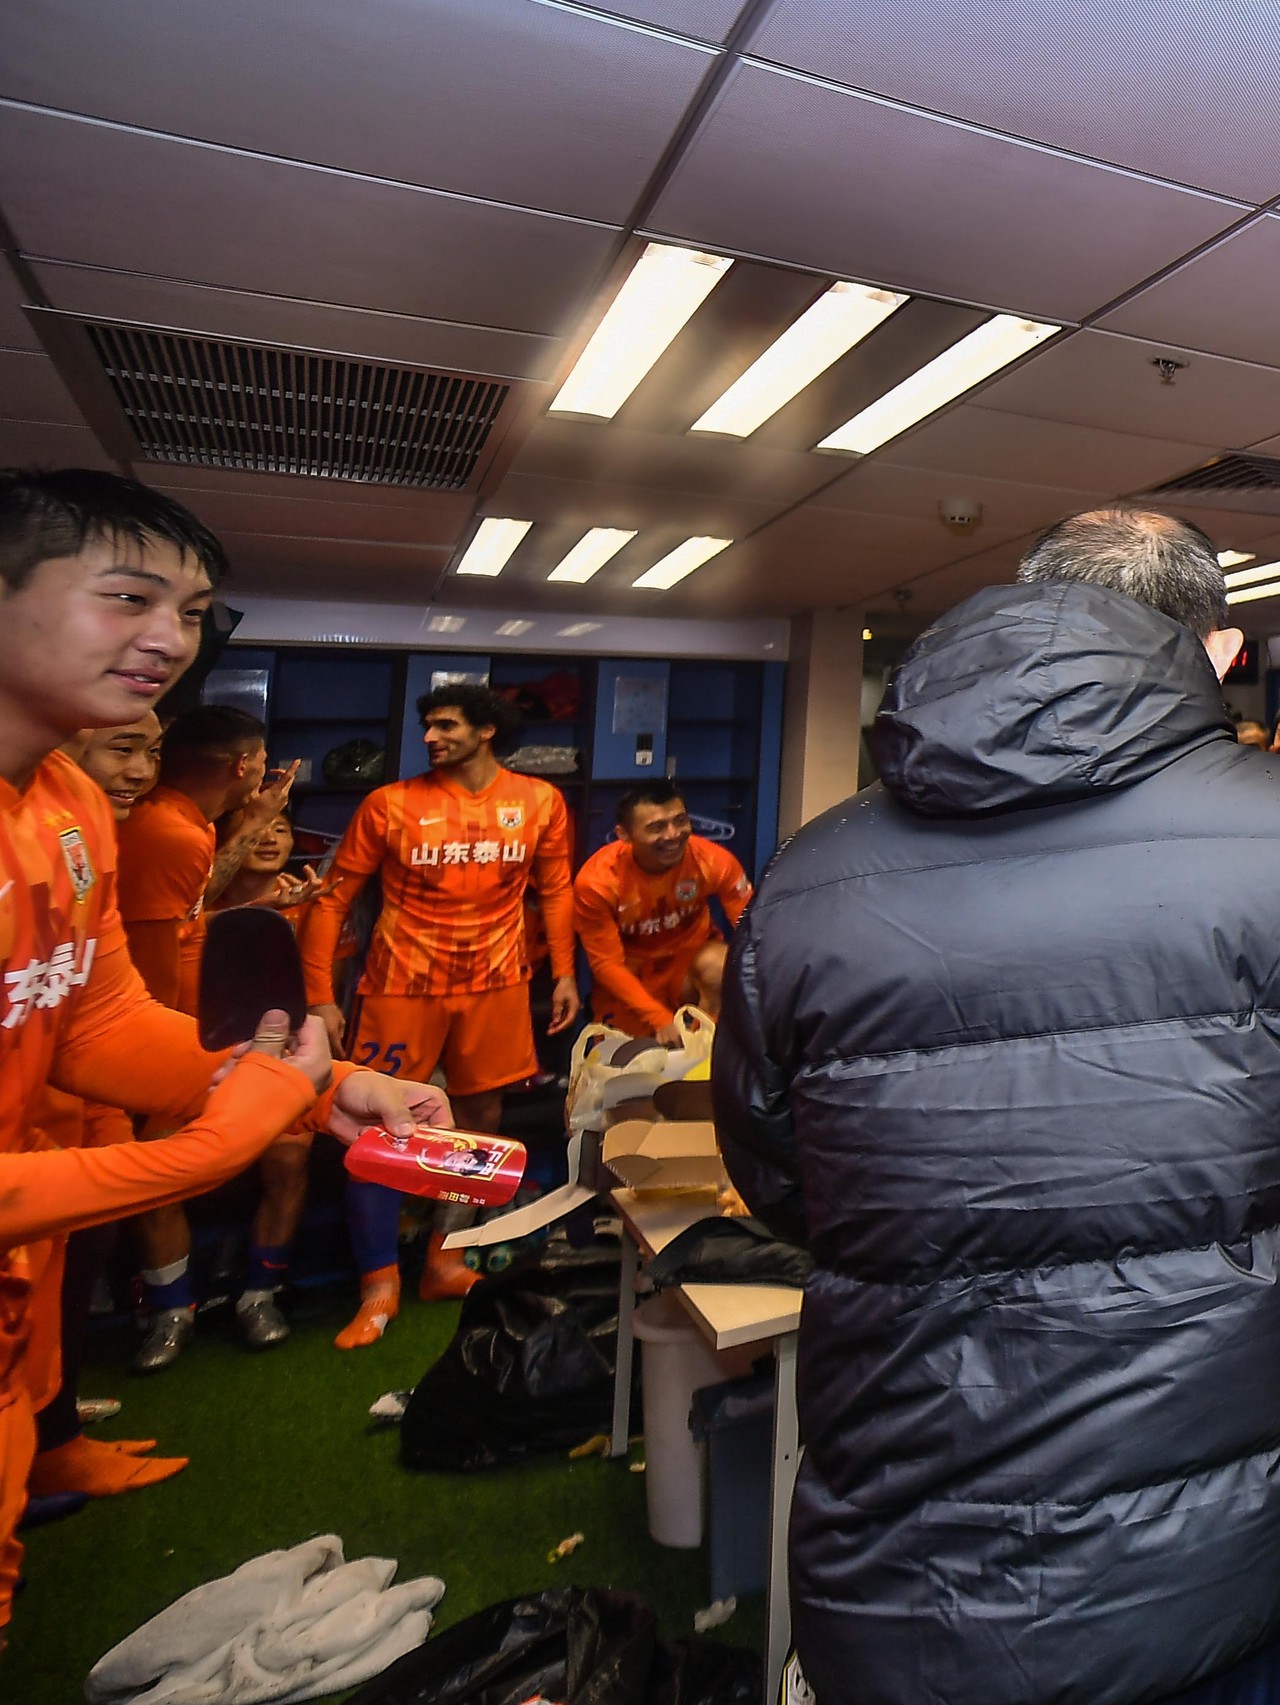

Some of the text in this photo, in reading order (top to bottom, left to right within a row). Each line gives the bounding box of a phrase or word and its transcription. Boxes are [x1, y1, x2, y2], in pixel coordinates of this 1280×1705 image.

[411, 840, 527, 866] 山东泰山
[361, 1041, 406, 1075] 25
